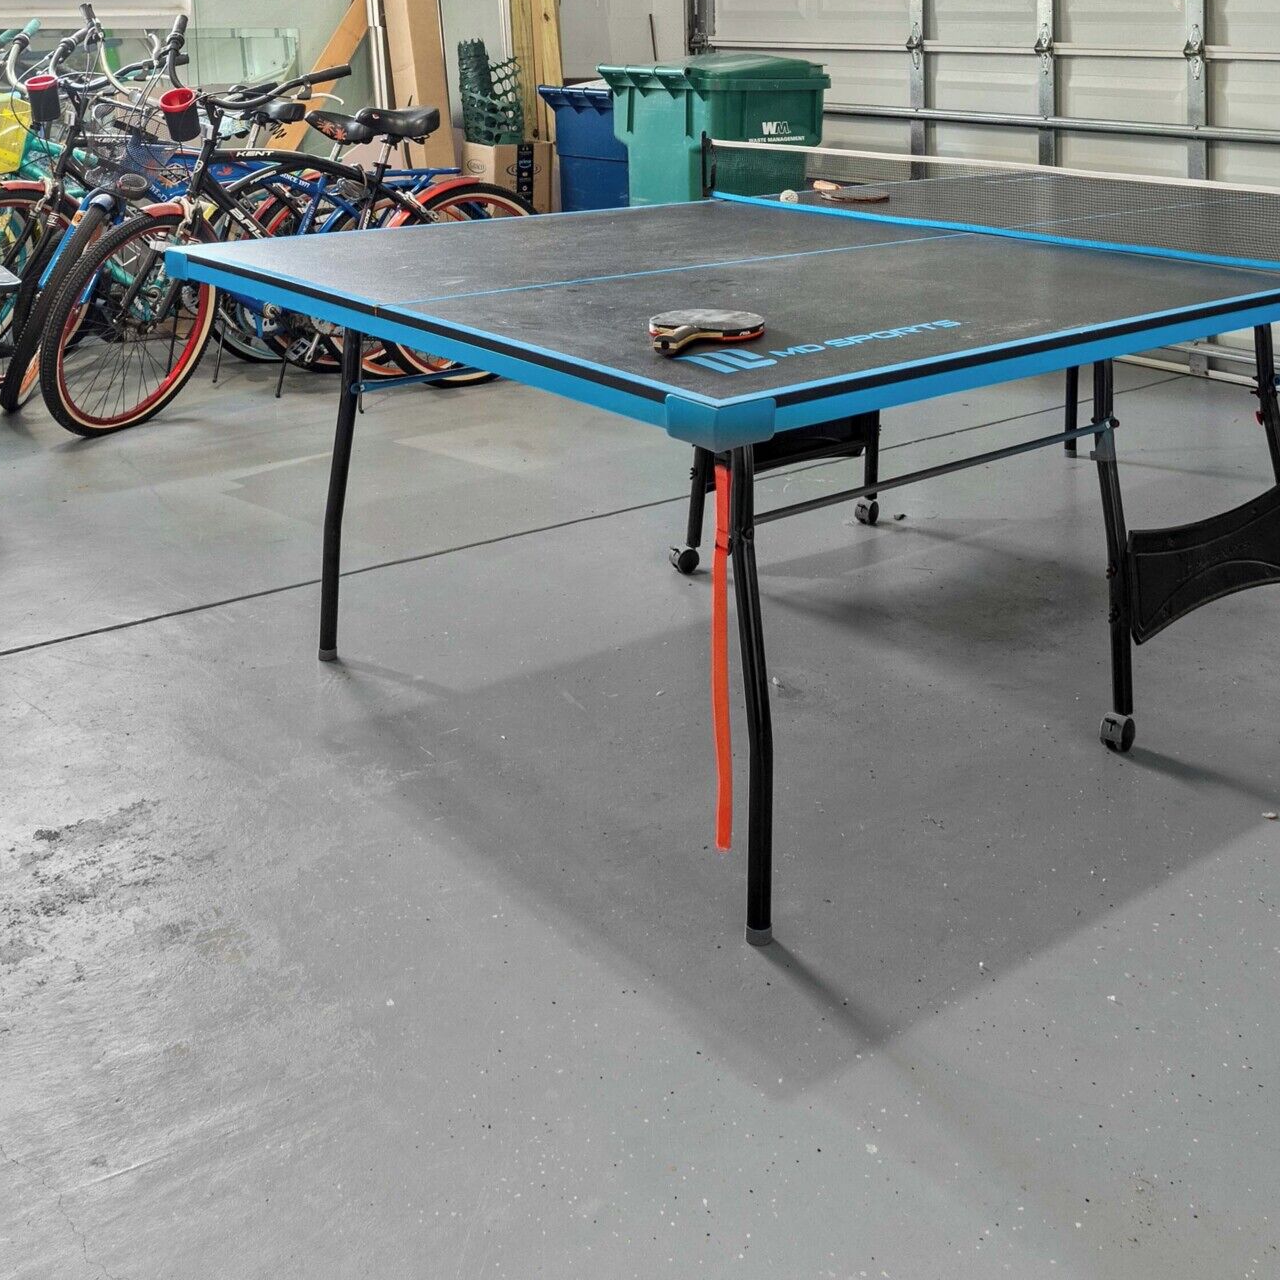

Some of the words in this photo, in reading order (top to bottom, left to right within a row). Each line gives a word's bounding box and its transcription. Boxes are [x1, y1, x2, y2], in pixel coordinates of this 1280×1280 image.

[762, 121, 791, 135] WM
[768, 343, 826, 358] MD
[824, 319, 962, 348] SPORTS
